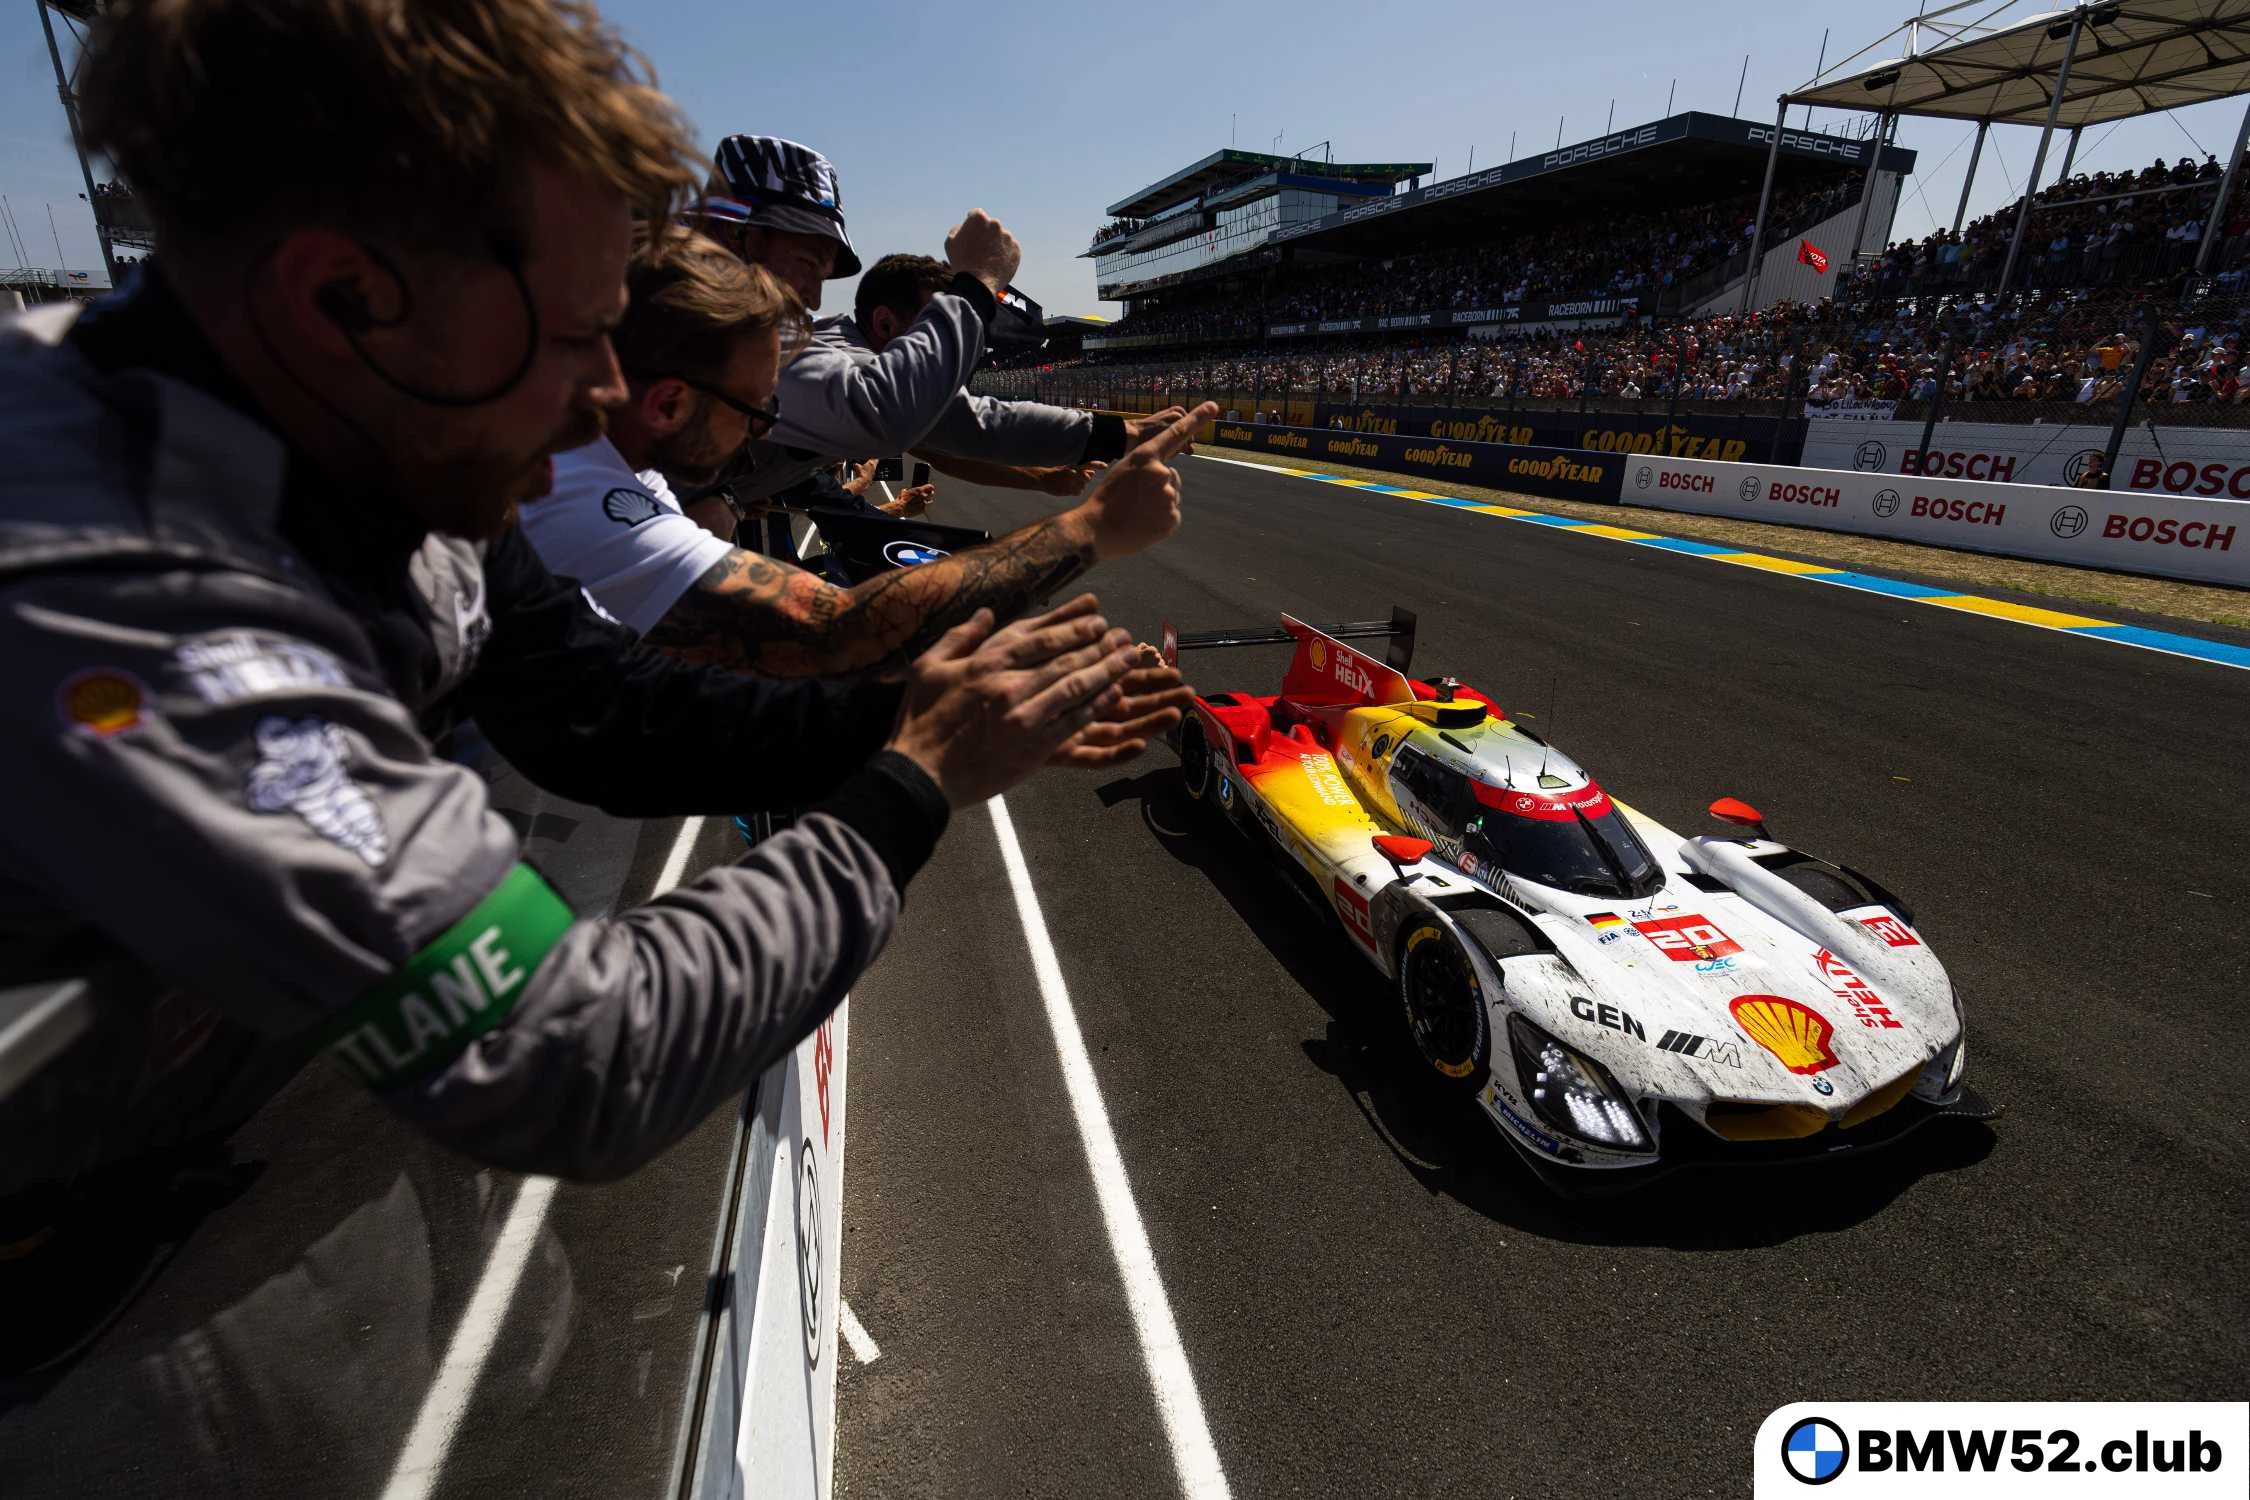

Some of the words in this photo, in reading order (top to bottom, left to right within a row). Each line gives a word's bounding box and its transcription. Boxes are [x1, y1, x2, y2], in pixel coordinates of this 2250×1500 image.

[1544, 126, 1658, 168] PORSCHE
[1748, 128, 1862, 159] PORSCHE
[1425, 170, 1503, 200] PORSCHE
[1344, 197, 1402, 222] PORSCHE
[1276, 221, 1321, 240] PORSCHE
[1453, 309, 1486, 322] RACEBORN
[1549, 300, 1593, 317] RACEBORN
[1378, 317, 1404, 328] RACBORN
[1220, 426, 1252, 441] GOODYEAR
[1268, 431, 1309, 449] GOODYEAR
[1583, 424, 1746, 462] GOODYEAR
[1328, 438, 1378, 457] GOODYEAR
[1404, 444, 1473, 468] GOODYEAR
[1508, 455, 1604, 483] GOODYEAR
[1900, 449, 2017, 483] BOSCH
[1659, 471, 1715, 493] BOSCH
[1769, 483, 1840, 507] BOSCH
[1911, 496, 2006, 525] BOSCH
[2103, 514, 2236, 551] BOSCH
[1336, 650, 1353, 668] Shell
[1335, 665, 1376, 699] HELIX
[1598, 931, 1620, 945] FIA
[1645, 925, 1728, 950] 20
[1810, 946, 1904, 1029] HELIX
[1570, 996, 1647, 1043] GEN
[1834, 991, 1880, 1028] Shell
